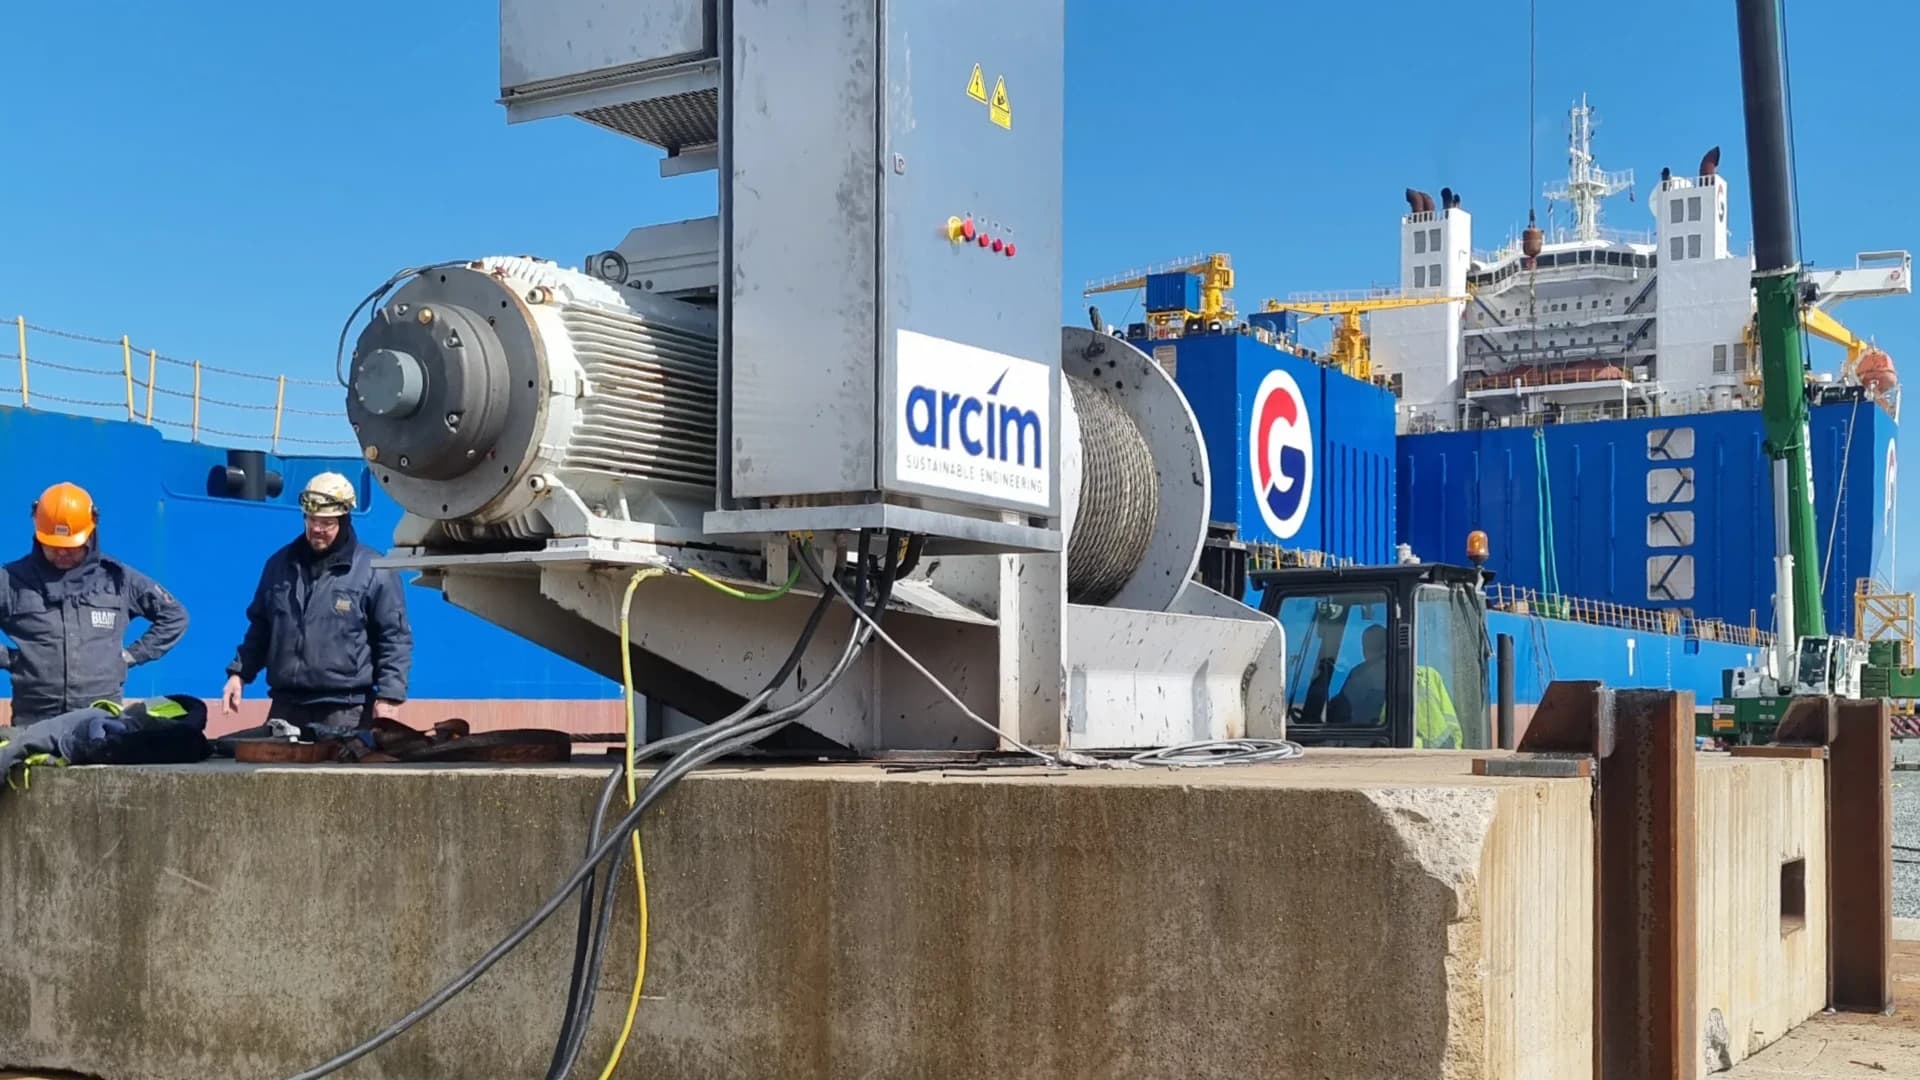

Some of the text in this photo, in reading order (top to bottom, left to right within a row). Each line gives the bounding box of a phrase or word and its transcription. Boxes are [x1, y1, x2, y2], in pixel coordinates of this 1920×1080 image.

[905, 366, 1042, 469] arcim
[1258, 387, 1306, 521] G
[905, 455, 1043, 494] SUSTAINABLE ENGINEERING
